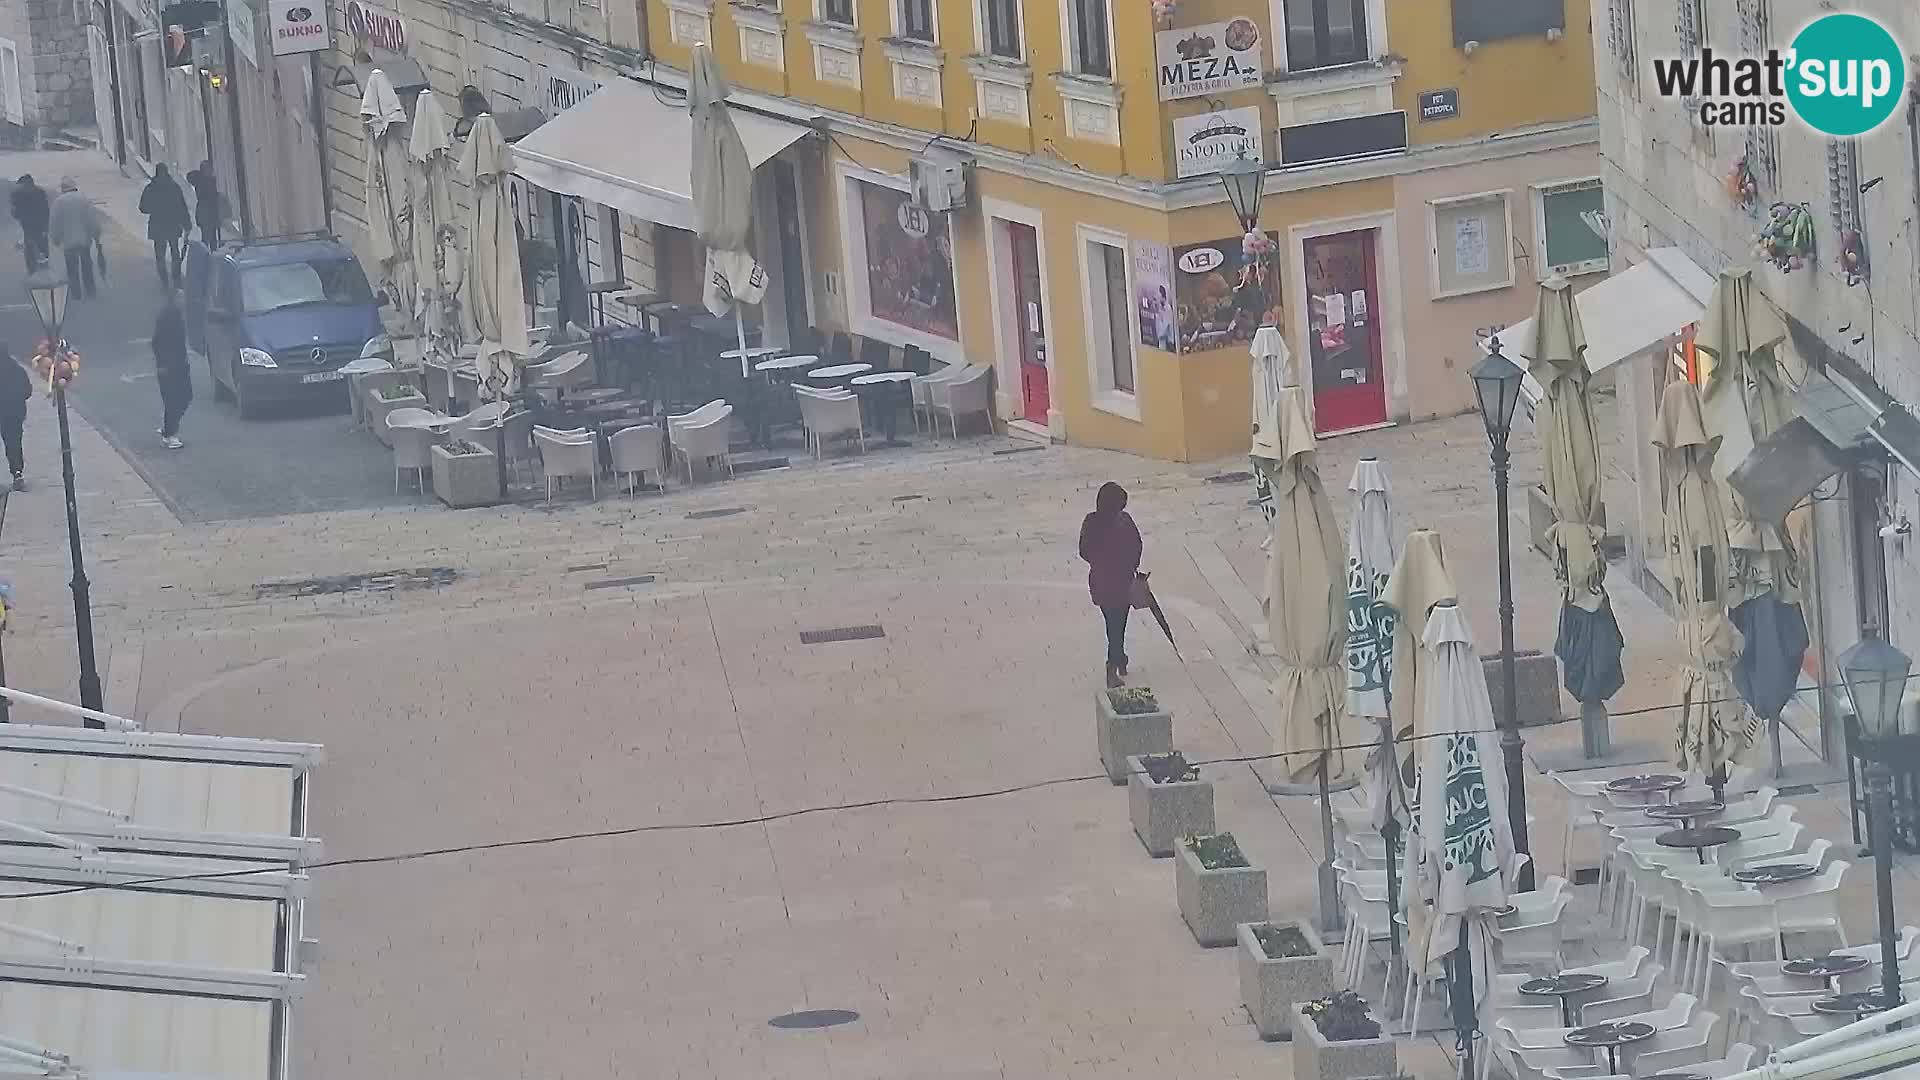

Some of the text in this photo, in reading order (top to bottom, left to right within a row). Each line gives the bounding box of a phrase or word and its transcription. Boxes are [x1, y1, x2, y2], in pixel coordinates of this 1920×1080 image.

[278, 24, 323, 40] SUKNO
[365, 9, 404, 51] SUKNO
[1161, 56, 1240, 86] MEZA
[1180, 143, 1226, 161] ISPOD
